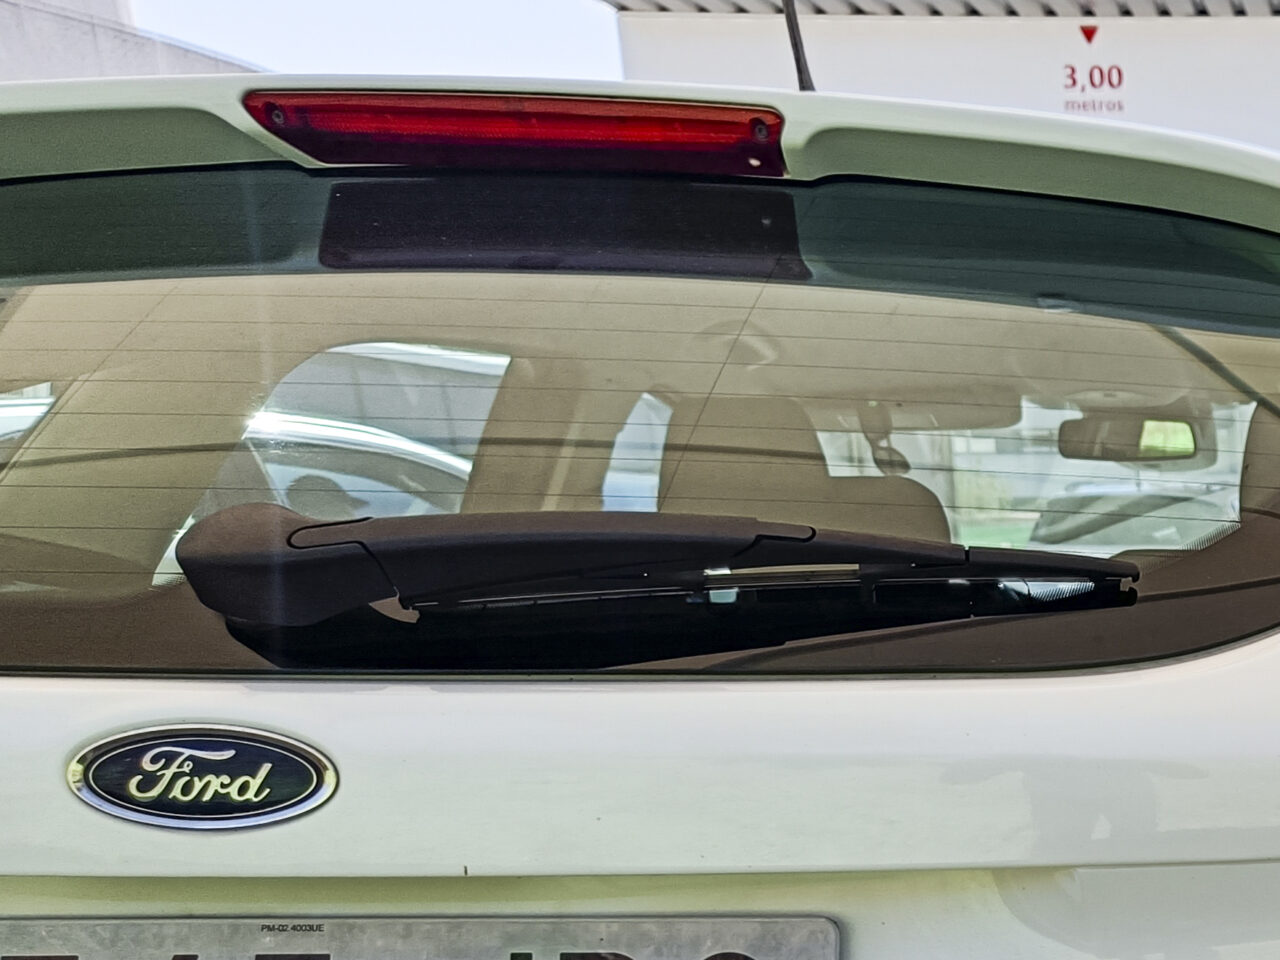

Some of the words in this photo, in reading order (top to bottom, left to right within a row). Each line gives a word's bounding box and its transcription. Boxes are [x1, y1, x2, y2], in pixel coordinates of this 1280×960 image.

[1063, 64, 1124, 93] 3,00
[1064, 99, 1124, 112] metros
[129, 746, 273, 802] Ford
